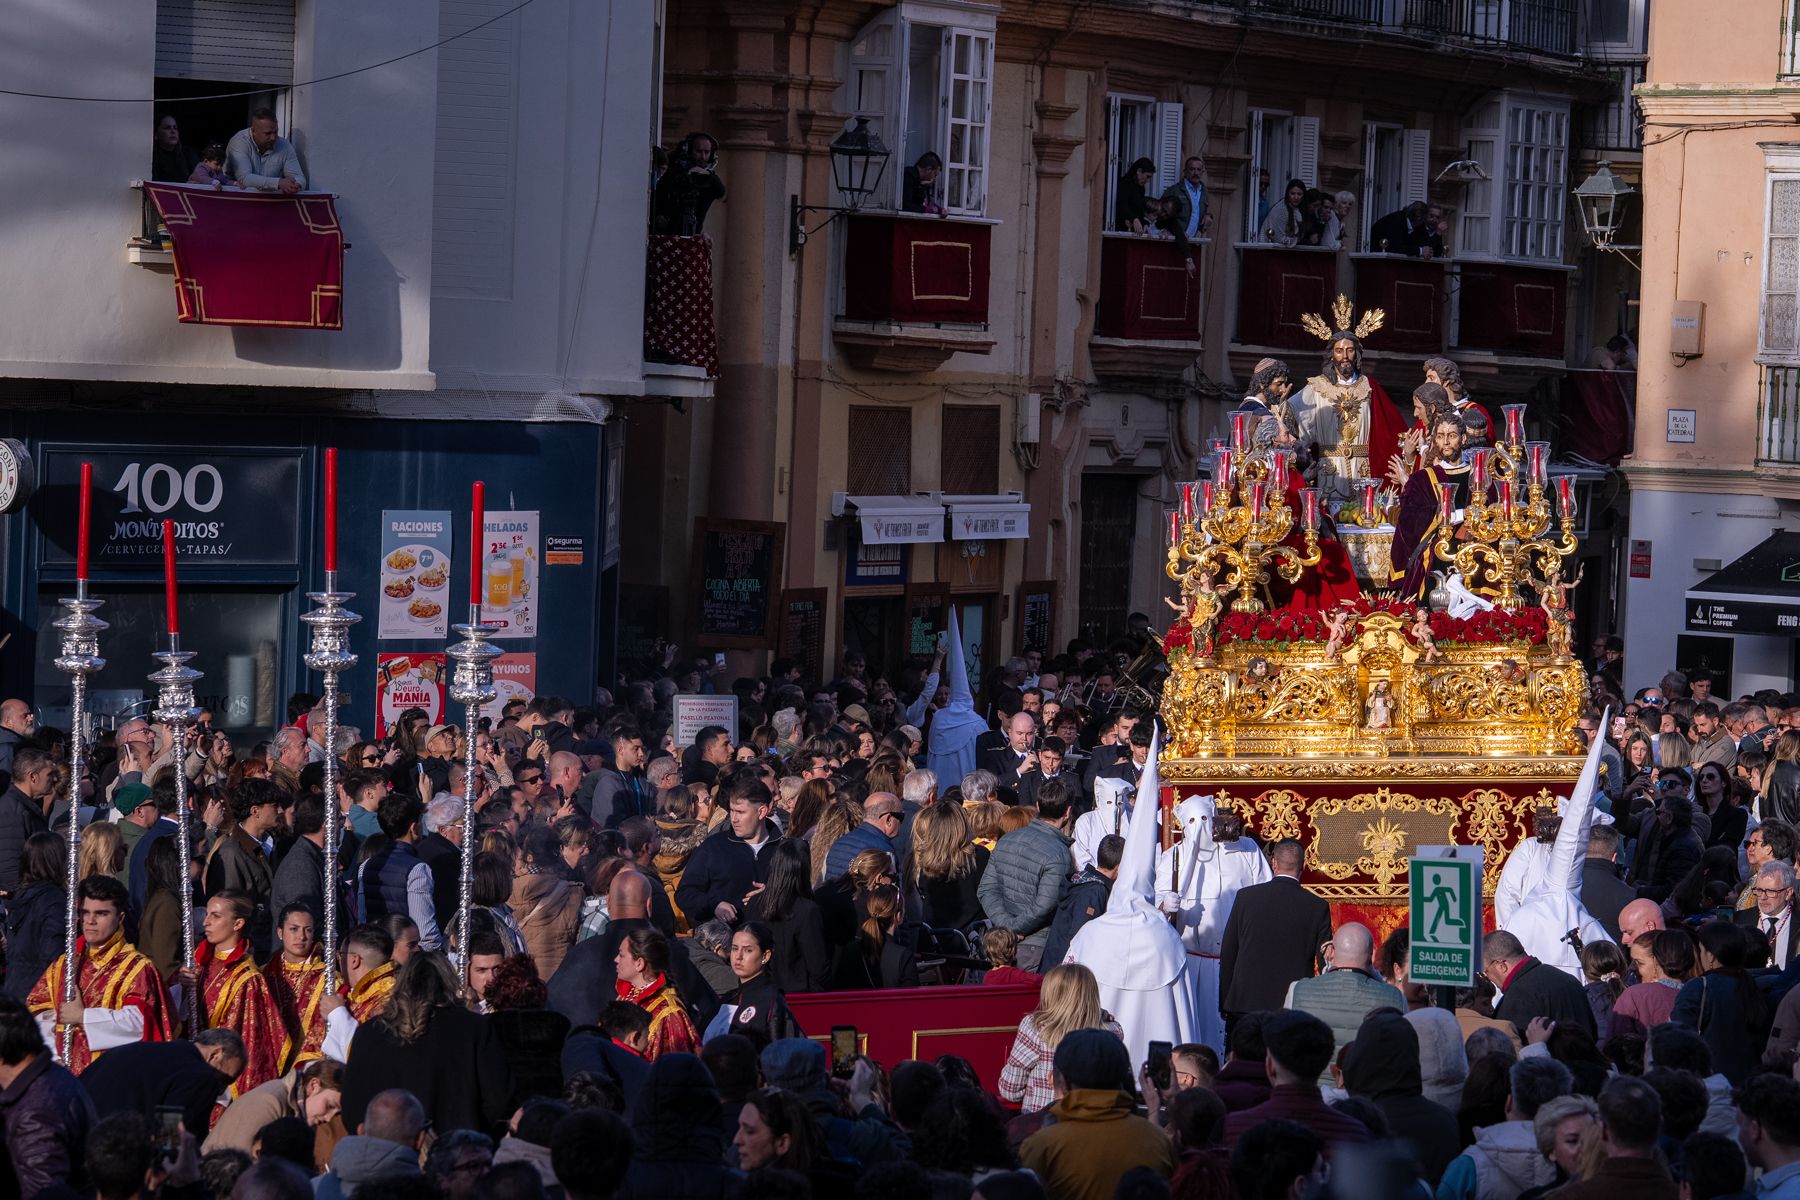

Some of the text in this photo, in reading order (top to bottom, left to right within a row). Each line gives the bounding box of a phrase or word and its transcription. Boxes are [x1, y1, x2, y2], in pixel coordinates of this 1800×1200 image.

[114, 462, 224, 513] 100
[391, 522, 443, 532] RACIONES
[484, 523, 529, 533] HELADAS
[554, 538, 583, 546] segurma
[705, 578, 760, 592] COCINA ABIERTA
[713, 591, 729, 601] TODO
[1777, 615, 1798, 627] FENG
[492, 664, 530, 674] AYUNOS
[393, 690, 431, 702] MANÍA
[1419, 950, 1463, 964] SALIDA DE
[1413, 964, 1468, 977] EMERGENCIA
